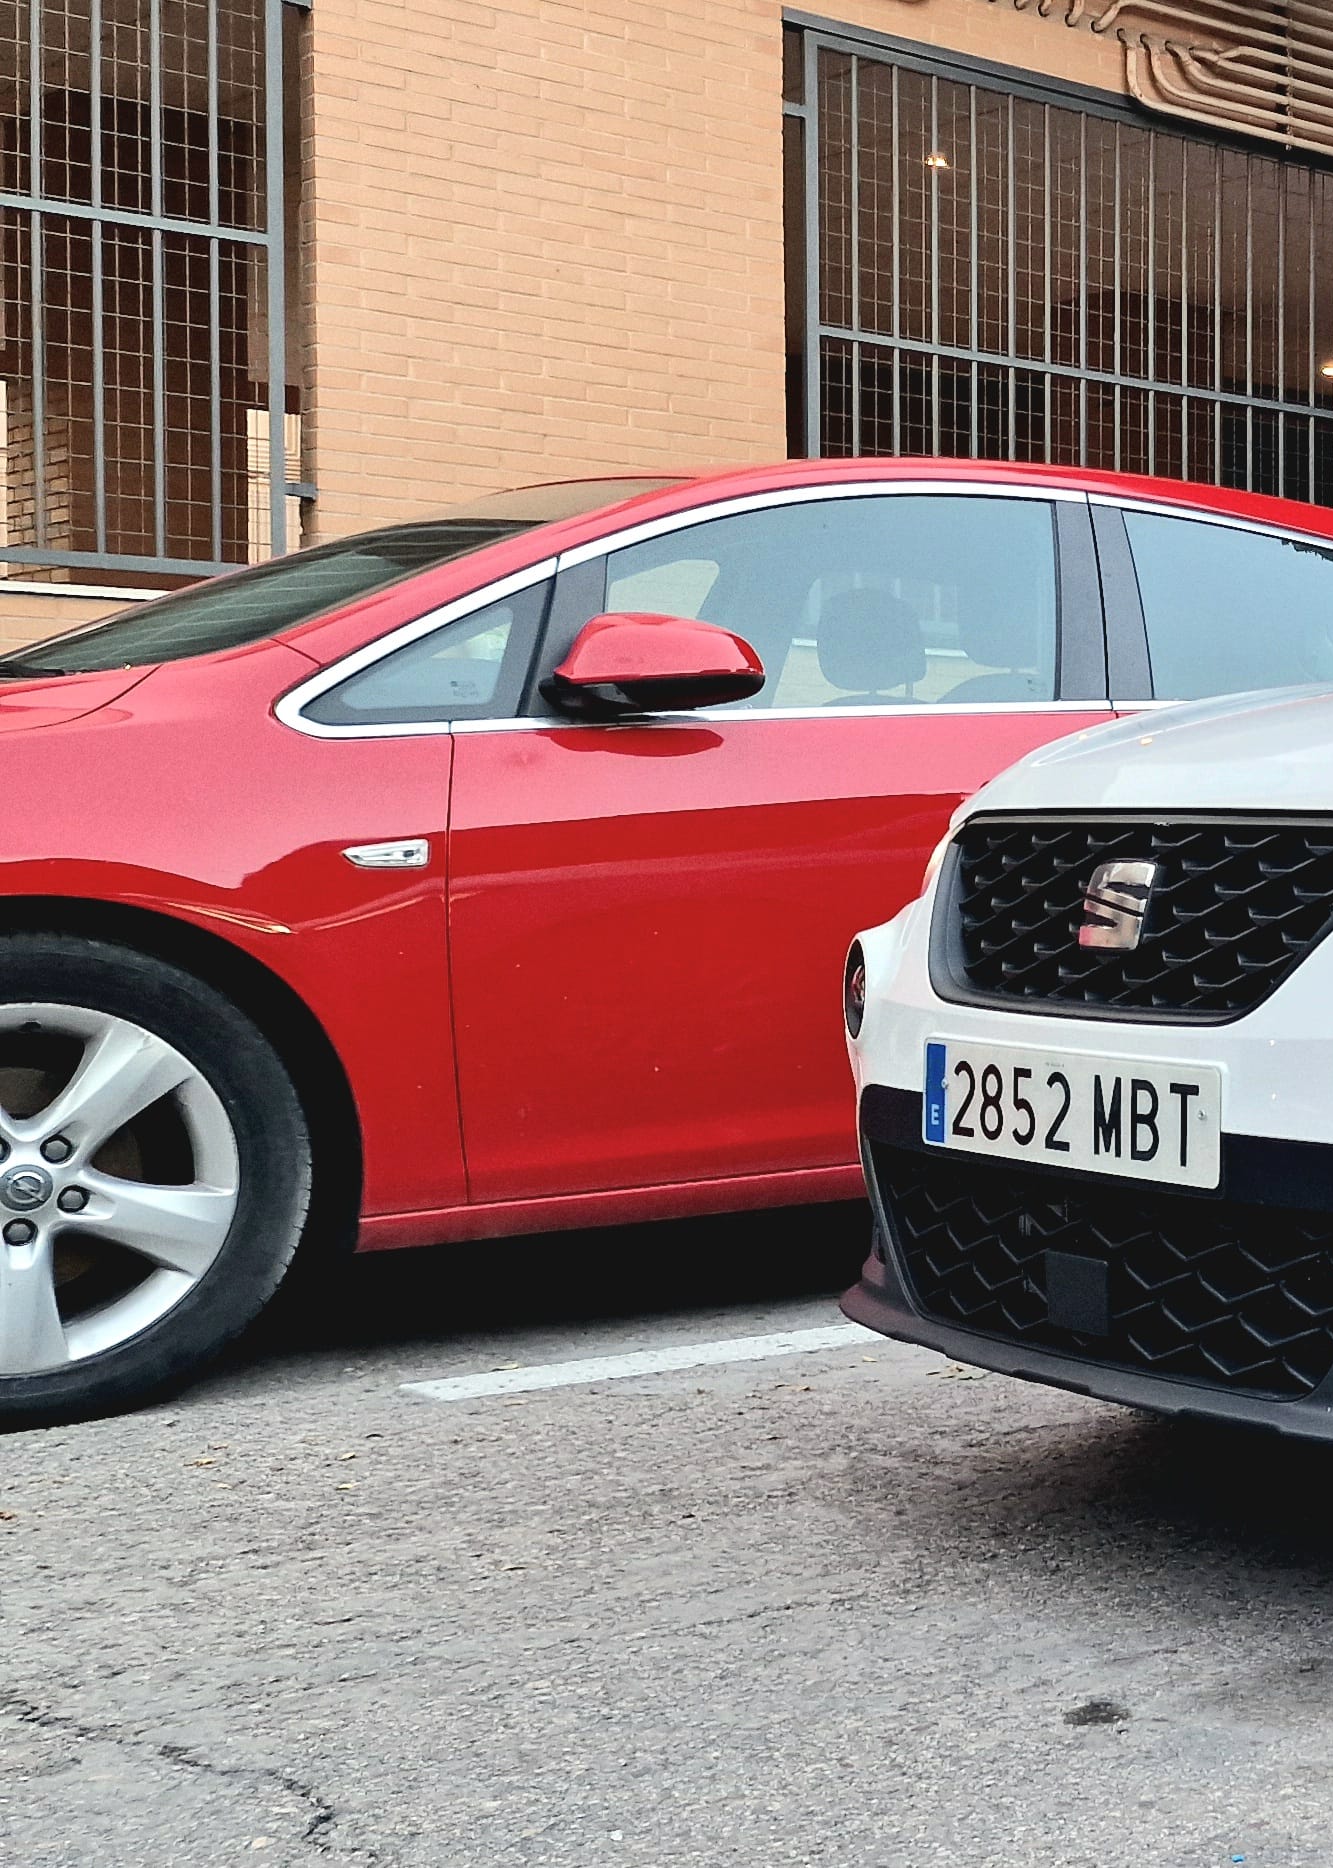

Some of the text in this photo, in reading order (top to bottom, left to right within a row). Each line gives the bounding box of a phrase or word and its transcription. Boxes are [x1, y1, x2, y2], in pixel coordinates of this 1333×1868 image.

[931, 1104, 940, 1126] E
[952, 1060, 1200, 1168] 2852 MBT
